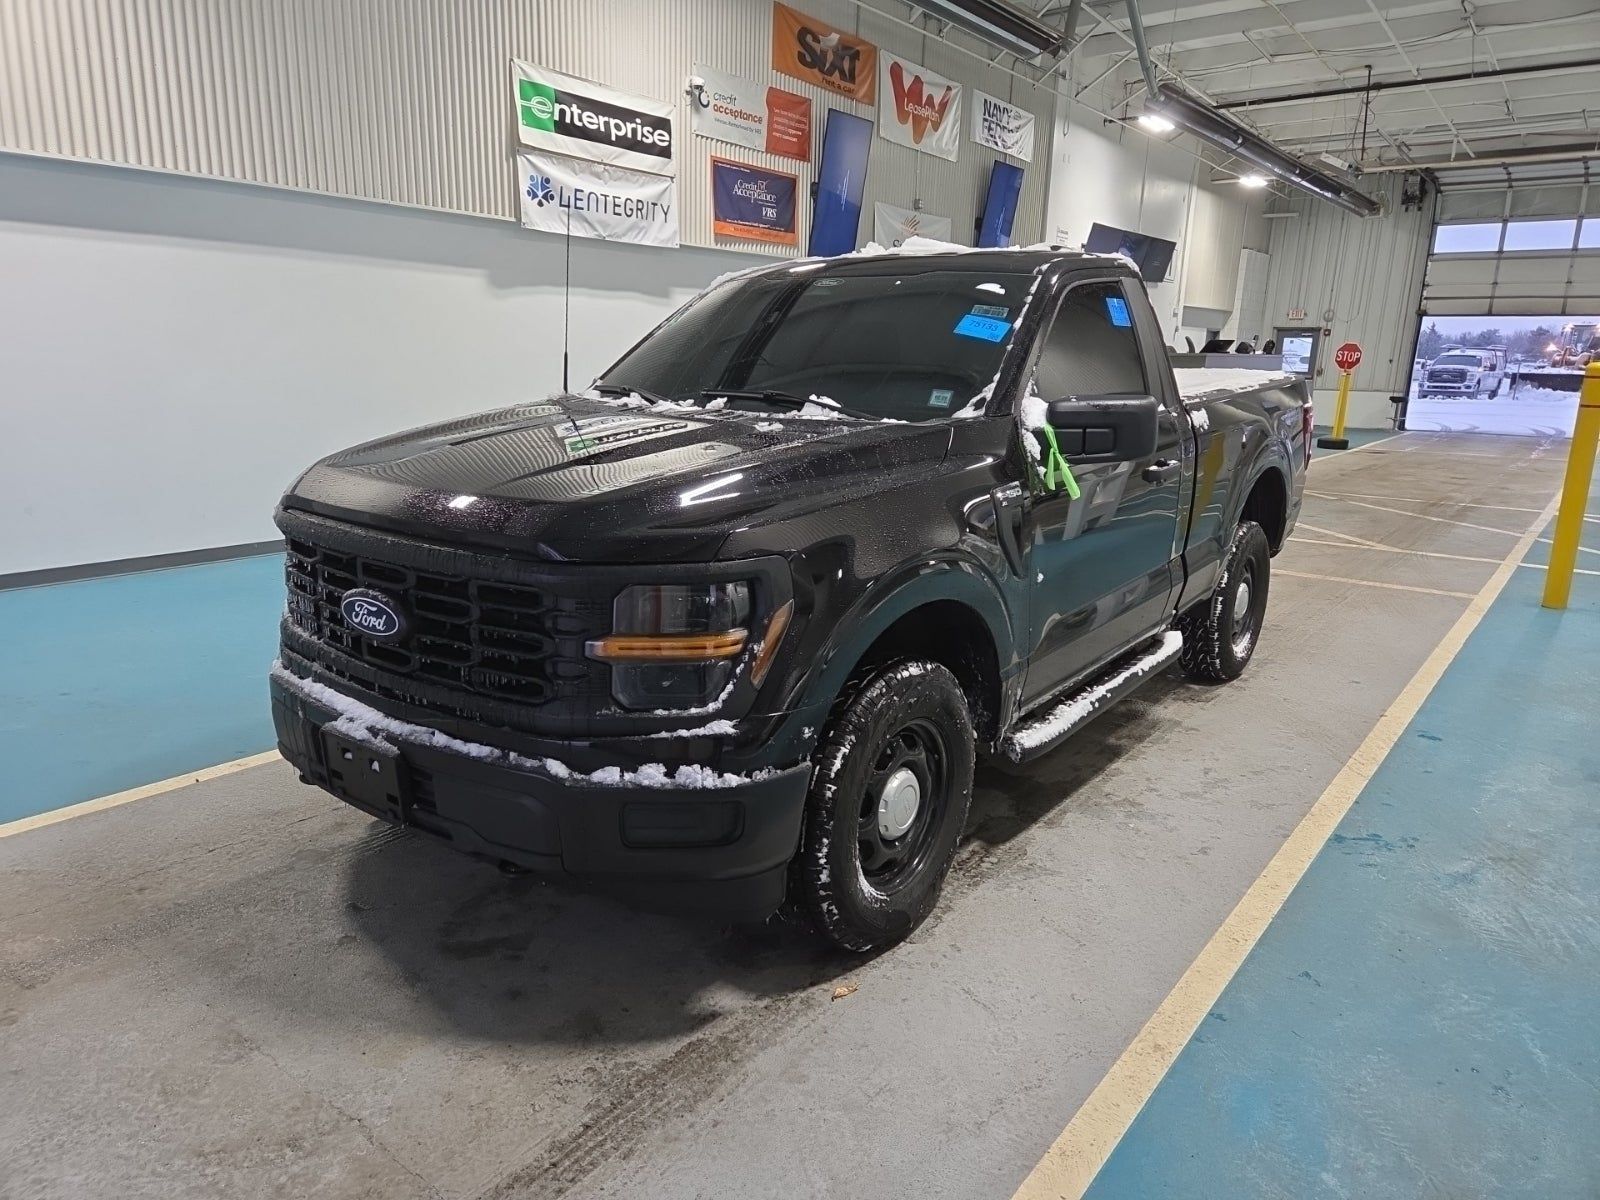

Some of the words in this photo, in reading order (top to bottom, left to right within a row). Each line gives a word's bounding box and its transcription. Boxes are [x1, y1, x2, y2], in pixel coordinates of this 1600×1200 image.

[713, 91, 737, 107] credit
[520, 96, 671, 147] enterprise
[713, 103, 763, 125] acceptance
[904, 101, 940, 123] LeasePlan
[983, 98, 1012, 126] NAVY
[732, 183, 777, 203] Acceptance
[737, 179, 757, 191] Credit
[559, 186, 671, 224] LENTEGRITY
[762, 206, 777, 218] VRS
[1291, 310, 1305, 319] EXIT
[1336, 350, 1361, 363] STOP
[352, 601, 387, 631] Ford
